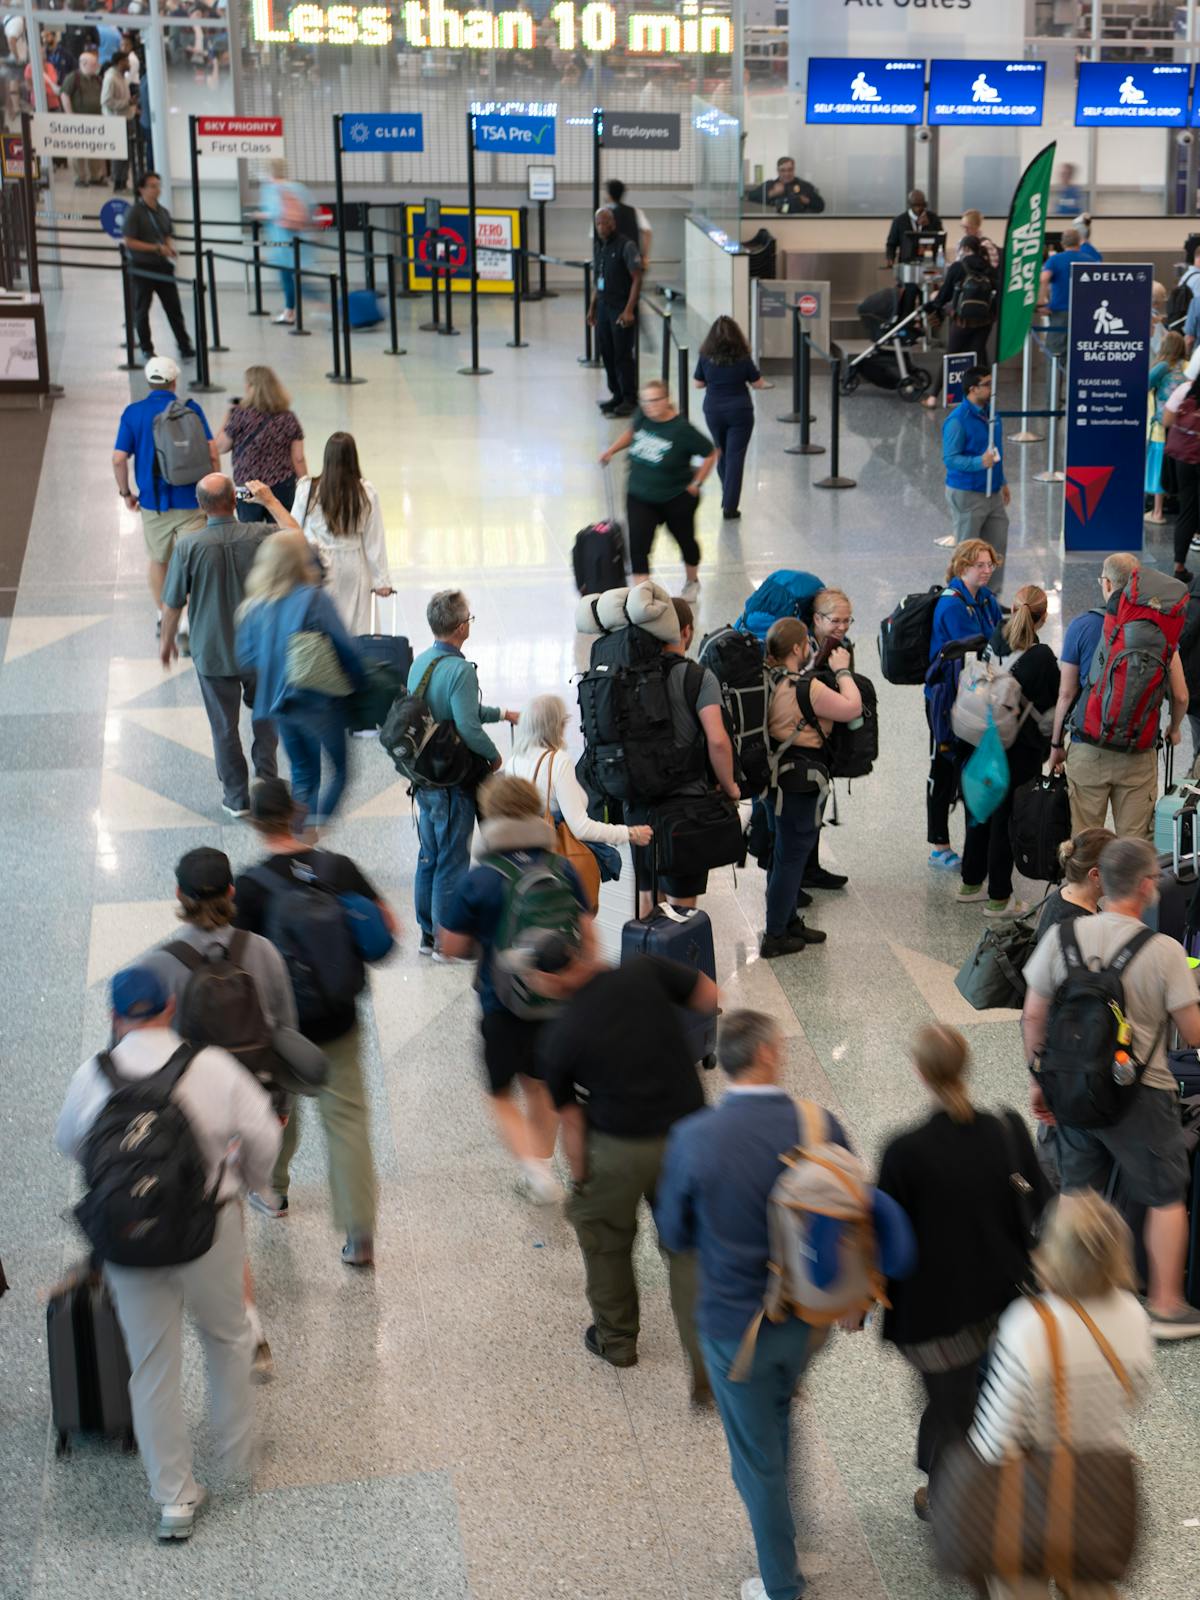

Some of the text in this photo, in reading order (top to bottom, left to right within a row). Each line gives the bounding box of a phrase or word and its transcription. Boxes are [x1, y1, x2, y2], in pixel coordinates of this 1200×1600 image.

[253, 0, 735, 54] Less than 10 min
[814, 104, 917, 114] SELF-SERVICE BAG DROP
[935, 105, 1036, 116] SELF-SERVICE BAG DROP
[1083, 107, 1182, 116] SELF-SERVICE BAG DROP
[49, 121, 105, 135] Standard
[204, 121, 277, 132] SKY PRIORITY
[612, 125, 669, 139] Employees
[375, 127, 416, 138] CLEAR
[481, 125, 532, 142] TSA Pre
[44, 136, 117, 153] Passengers
[211, 140, 271, 154] First Class
[478, 223, 503, 237] ZERO
[1093, 272, 1134, 281] DELTA
[1077, 341, 1144, 351] SELF-SERVICE
[1084, 352, 1136, 361] BAG DROP
[1078, 378, 1100, 386] PLEASE
